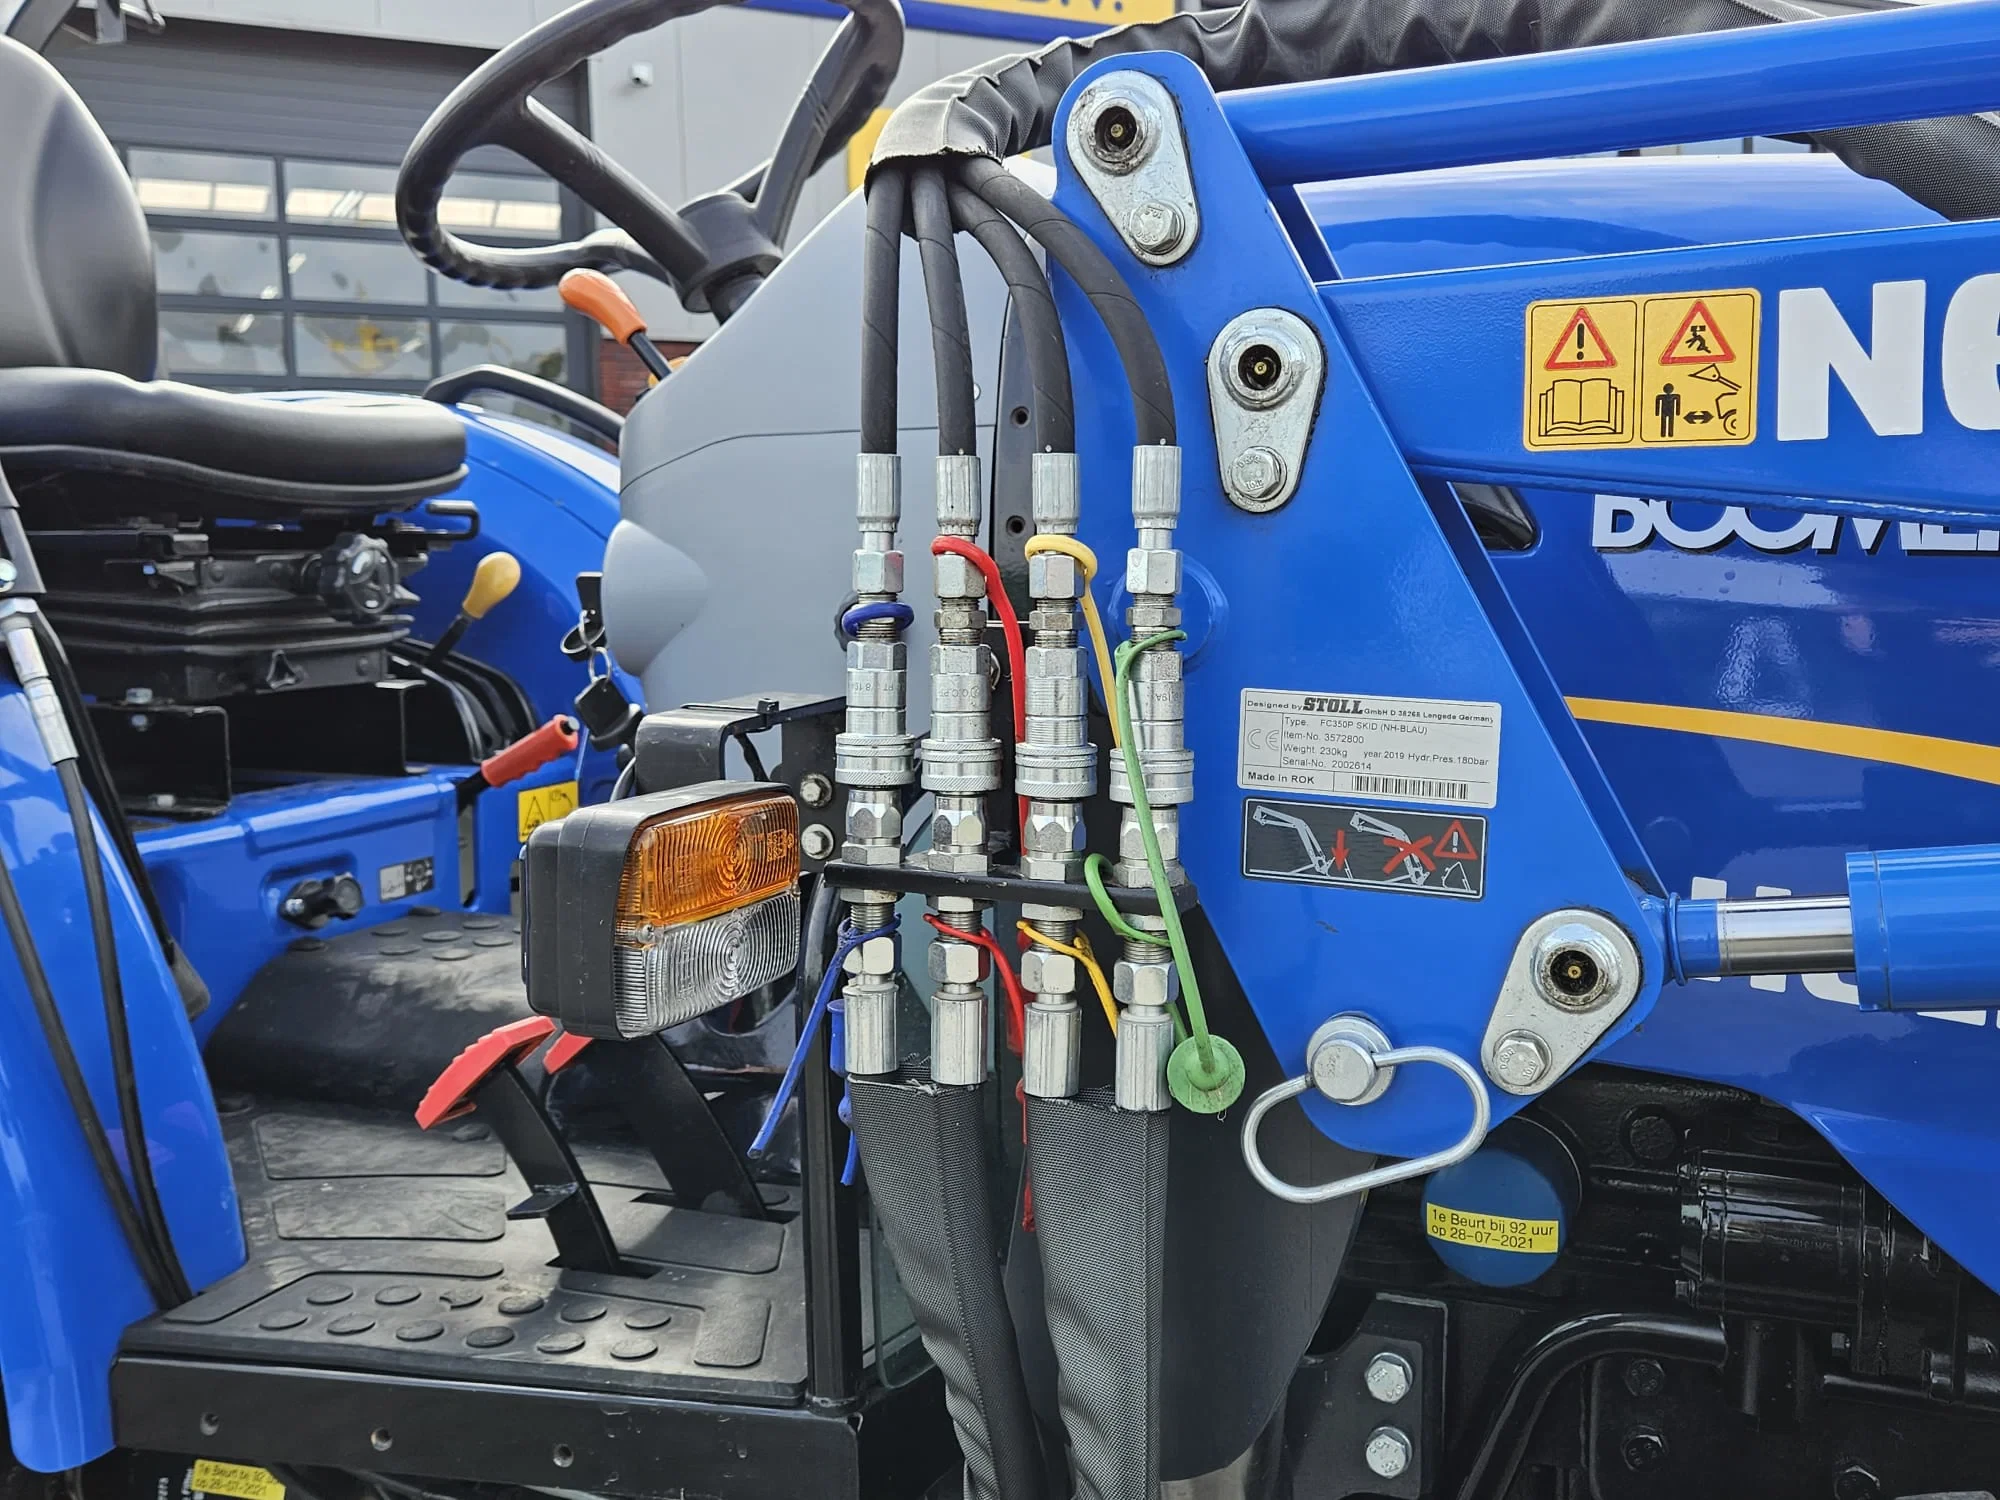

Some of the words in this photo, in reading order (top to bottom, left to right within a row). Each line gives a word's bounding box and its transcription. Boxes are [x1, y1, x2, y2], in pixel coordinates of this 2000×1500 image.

[1247, 700, 1289, 710] Designed
[1291, 703, 1303, 711] by
[1302, 697, 1364, 714] STOLL
[1364, 708, 1388, 716] GmbH
[1422, 711, 1457, 721] Lengede
[1458, 714, 1494, 724] Germany
[1320, 719, 1354, 729] FC350P
[1356, 721, 1378, 731] SKID
[1380, 723, 1428, 735] (NH-BLAU)
[1324, 733, 1364, 744] 3572800
[1319, 746, 1348, 758] 230kg
[1331, 760, 1372, 771] 2002614
[1247, 771, 1275, 782] Made
[1291, 775, 1315, 785] ROK
[1432, 1209, 1446, 1222] 1e
[1450, 1213, 1486, 1230] Beurt
[1489, 1218, 1506, 1233] bij
[1509, 1221, 1527, 1235] 92
[1531, 1225, 1555, 1236] uur
[1431, 1224, 1447, 1237] op
[1450, 1227, 1533, 1249] 28-07-2021
